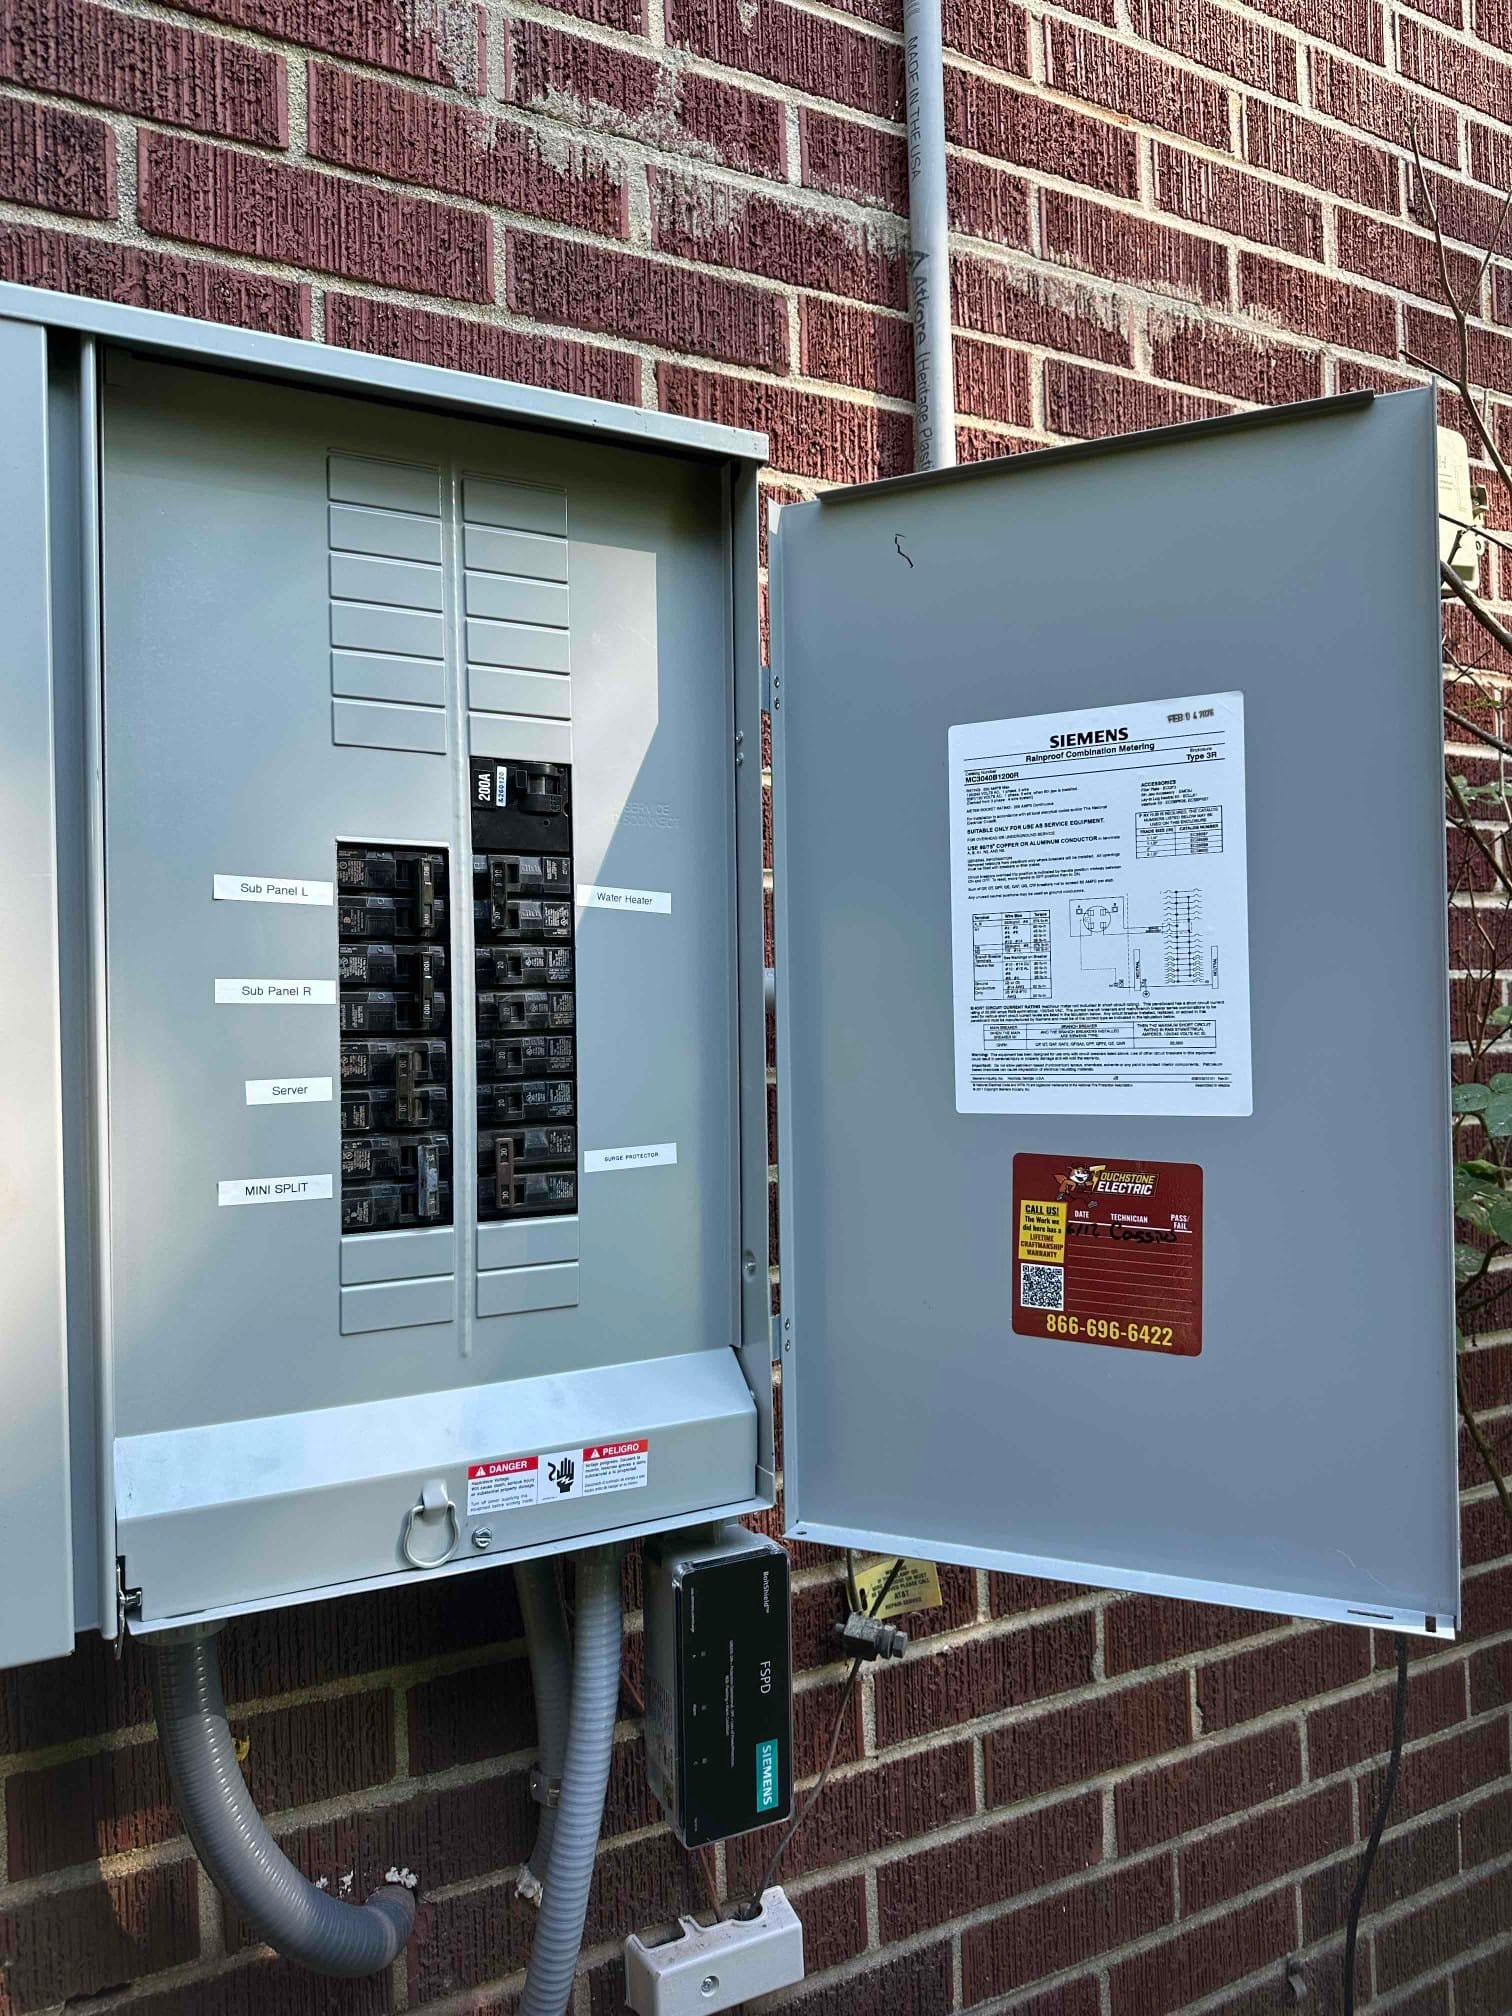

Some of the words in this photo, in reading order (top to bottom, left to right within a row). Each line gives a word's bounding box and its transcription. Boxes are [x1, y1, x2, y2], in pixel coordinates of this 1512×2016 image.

[907, 35, 920, 88] MADE
[908, 87, 920, 107] IN
[909, 106, 921, 147] THE
[910, 145, 922, 181] USA
[912, 276, 929, 346] Atkore
[1050, 727, 1129, 749] SIEMENS
[1025, 752, 1064, 763] Rainproof
[1065, 747, 1117, 759] Combination
[1118, 742, 1155, 754] Metering
[1186, 753, 1205, 763] Type
[1206, 751, 1217, 759] 3R
[965, 772, 1020, 784] MC3040B1200R
[478, 773, 491, 802] 200A
[967, 827, 994, 835] SUITABLE
[994, 825, 1009, 833] ONLY
[1029, 838, 1060, 846] ALUMINUM
[1060, 835, 1098, 844] CONDUCTOR
[240, 882, 263, 895] Sub
[266, 884, 299, 897] Panel
[301, 886, 309, 897] L
[596, 892, 622, 903] Water
[625, 895, 653, 905] Heater
[497, 960, 504, 969] 20
[241, 985, 264, 997] Sub
[268, 985, 300, 997] Panel
[302, 986, 312, 997] R
[498, 1051, 506, 1060] 20
[271, 1084, 309, 1097] Server
[498, 1099, 505, 1107] 20
[500, 1147, 508, 1157] 30
[625, 1152, 659, 1160] PROTECTOR
[245, 1184, 271, 1197] MINI
[273, 1181, 309, 1195] SPLIT
[1096, 1181, 1153, 1196] ELECTRIC
[1025, 1204, 1045, 1215] CALL
[1046, 1206, 1060, 1217] US!
[1074, 1210, 1090, 1219] DATE
[1025, 1215, 1035, 1223] The
[1110, 1212, 1149, 1224] TECHNICIAN
[1170, 1213, 1191, 1224] PASS/
[1022, 1223, 1032, 1231] did
[1032, 1224, 1046, 1233] here
[1173, 1221, 1187, 1230] FAIL
[1030, 1234, 1055, 1242] LIFETIME
[1020, 1240, 1064, 1251] CRAFTMANSHIP
[1026, 1250, 1057, 1258] WARRANTY
[1046, 1313, 1173, 1346] 866-696-6422
[602, 1443, 640, 1456] PELIGRO
[489, 1460, 528, 1474] DANGER
[894, 1590, 910, 1600] AT&T
[759, 1660, 771, 1695] FSPD
[761, 1743, 773, 1807] SIEMENS
